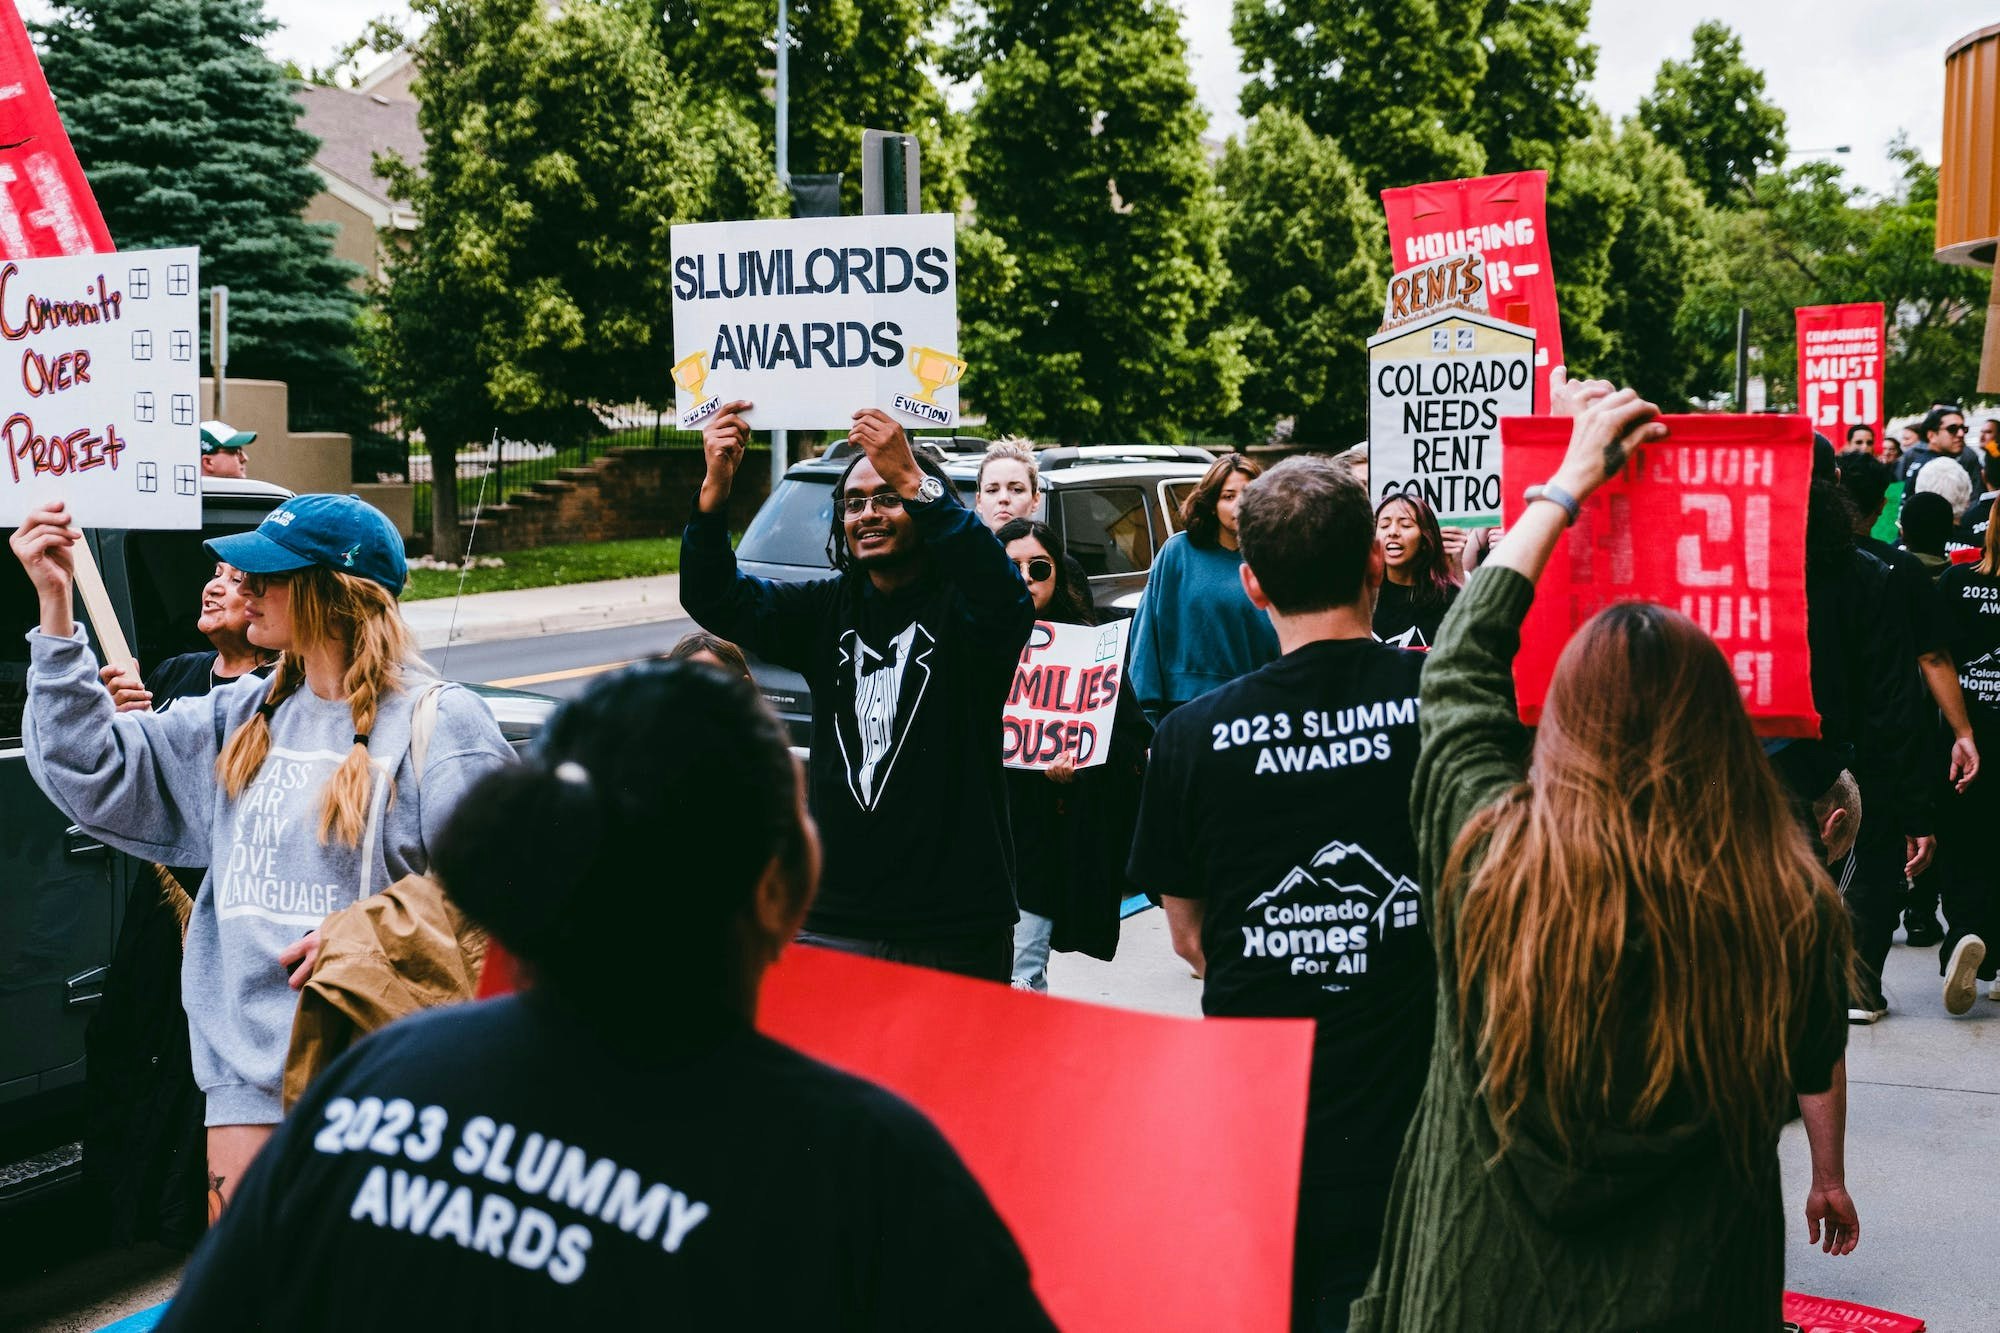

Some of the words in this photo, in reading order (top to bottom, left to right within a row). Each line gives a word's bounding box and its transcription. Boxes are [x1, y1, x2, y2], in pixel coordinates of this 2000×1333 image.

[1406, 218, 1535, 263] HOUSING
[674, 247, 949, 301] SLUMLORDS
[1392, 254, 1483, 319] RENT$
[710, 321, 904, 370] AWARDS
[22, 348, 91, 397] OVER
[1378, 359, 1528, 397] COLORADO
[1806, 355, 1878, 380] MUST
[894, 395, 948, 422] EVICTION
[1403, 398, 1498, 434] NEEDS
[1806, 379, 1878, 426] GO
[1413, 435, 1490, 474] RENT
[1962, 585, 1998, 600] 2023
[1007, 664, 1119, 714] MILIES
[1002, 714, 1098, 766] OUSED
[1212, 713, 1292, 750] 2023
[1302, 698, 1421, 738] SLUMM
[1254, 733, 1392, 775] AWARDS
[252, 815, 289, 846] MY
[1264, 899, 1369, 926] Colorado
[1242, 925, 1368, 958] Homes
[1290, 956, 1330, 976] For
[1335, 953, 1367, 974] All
[314, 1096, 448, 1162] 2023
[452, 1114, 710, 1253] SLUMMY
[349, 1164, 593, 1284] AWARDS
